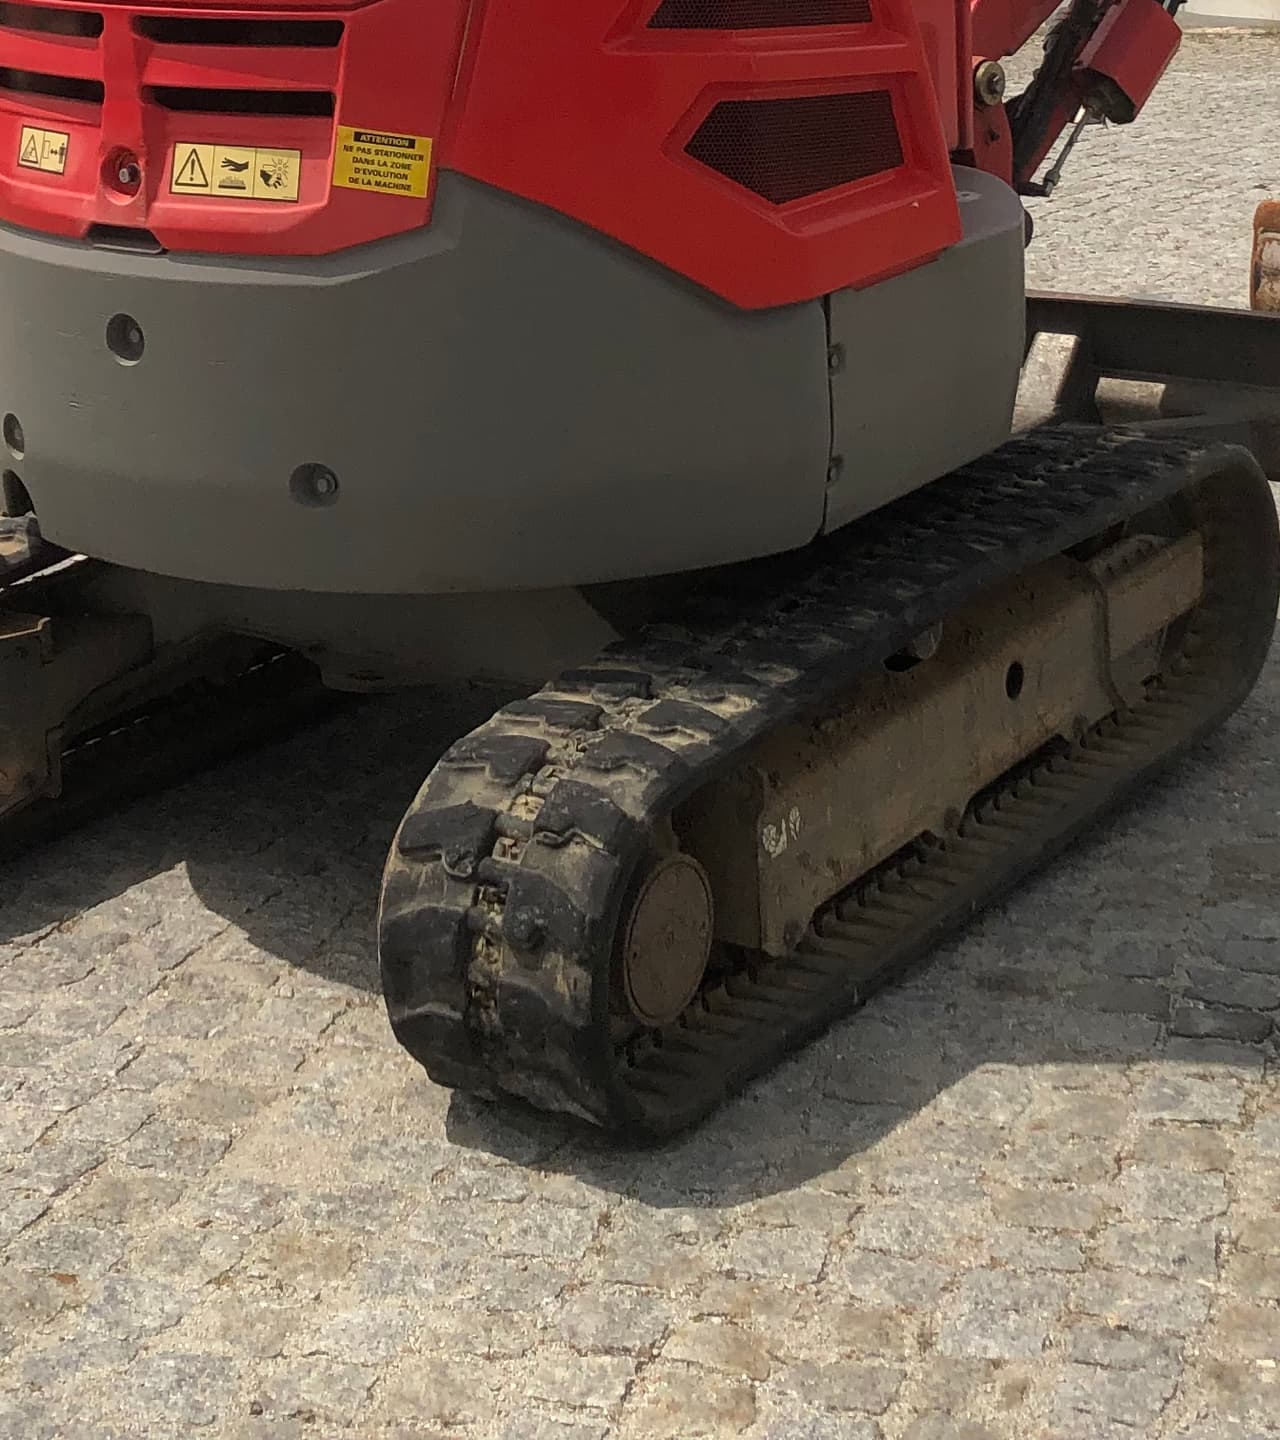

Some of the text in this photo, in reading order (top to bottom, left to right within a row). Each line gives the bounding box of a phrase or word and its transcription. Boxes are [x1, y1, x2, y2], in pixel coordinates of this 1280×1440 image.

[359, 134, 409, 147] ATTENTION
[343, 144, 424, 162] NE PAS STATIONNER
[352, 156, 413, 171] DANS LA ZONE
[348, 176, 412, 192] DE LA MACHINE
